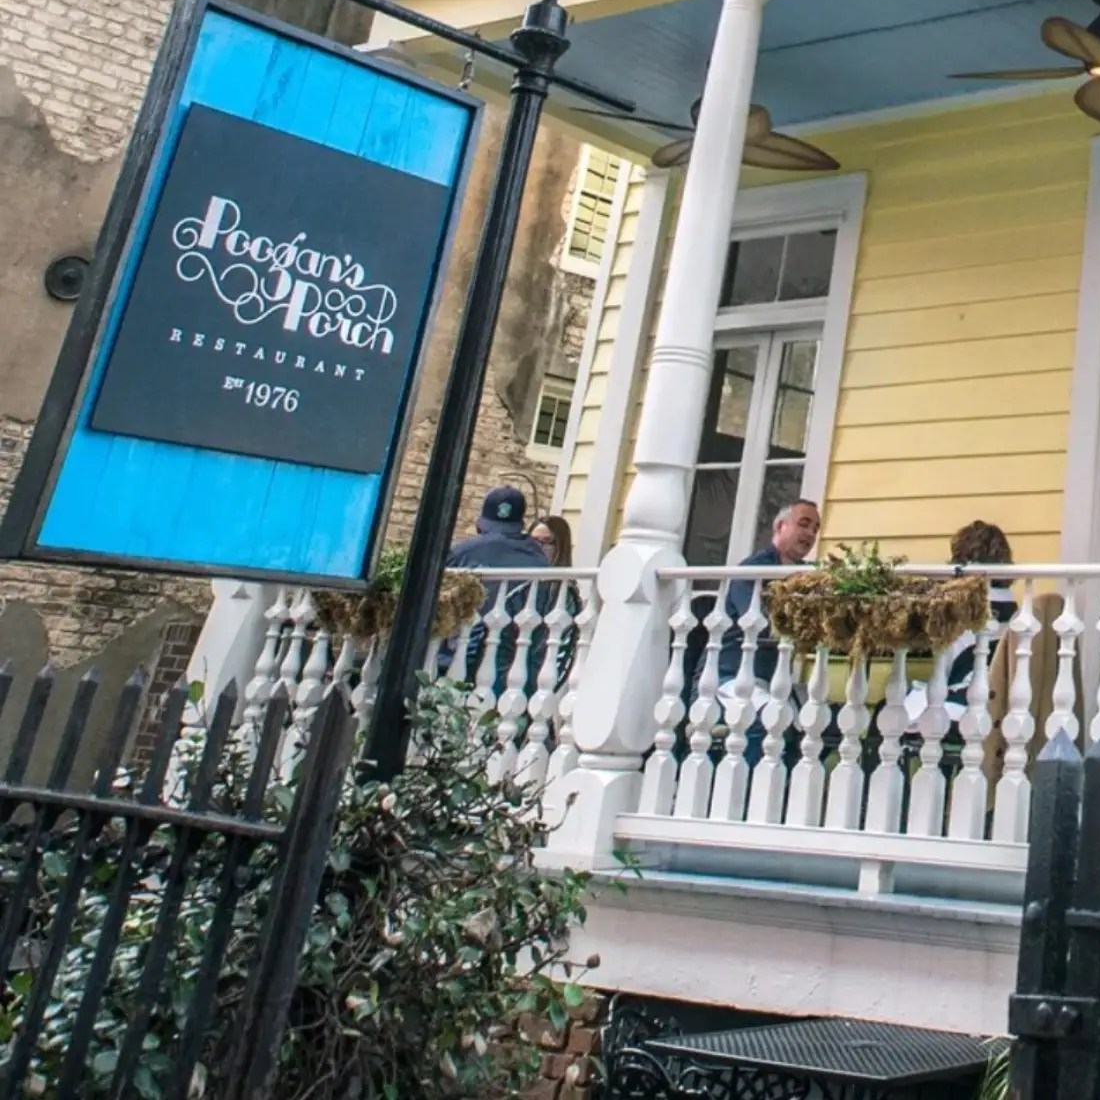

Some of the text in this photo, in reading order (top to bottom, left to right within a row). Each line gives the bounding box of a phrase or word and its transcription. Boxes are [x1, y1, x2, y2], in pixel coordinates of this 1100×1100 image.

[173, 195, 366, 300] Poogan's
[281, 279, 395, 354] Porch
[169, 327, 366, 382] RESTAURANT
[244, 380, 301, 413] 1976
